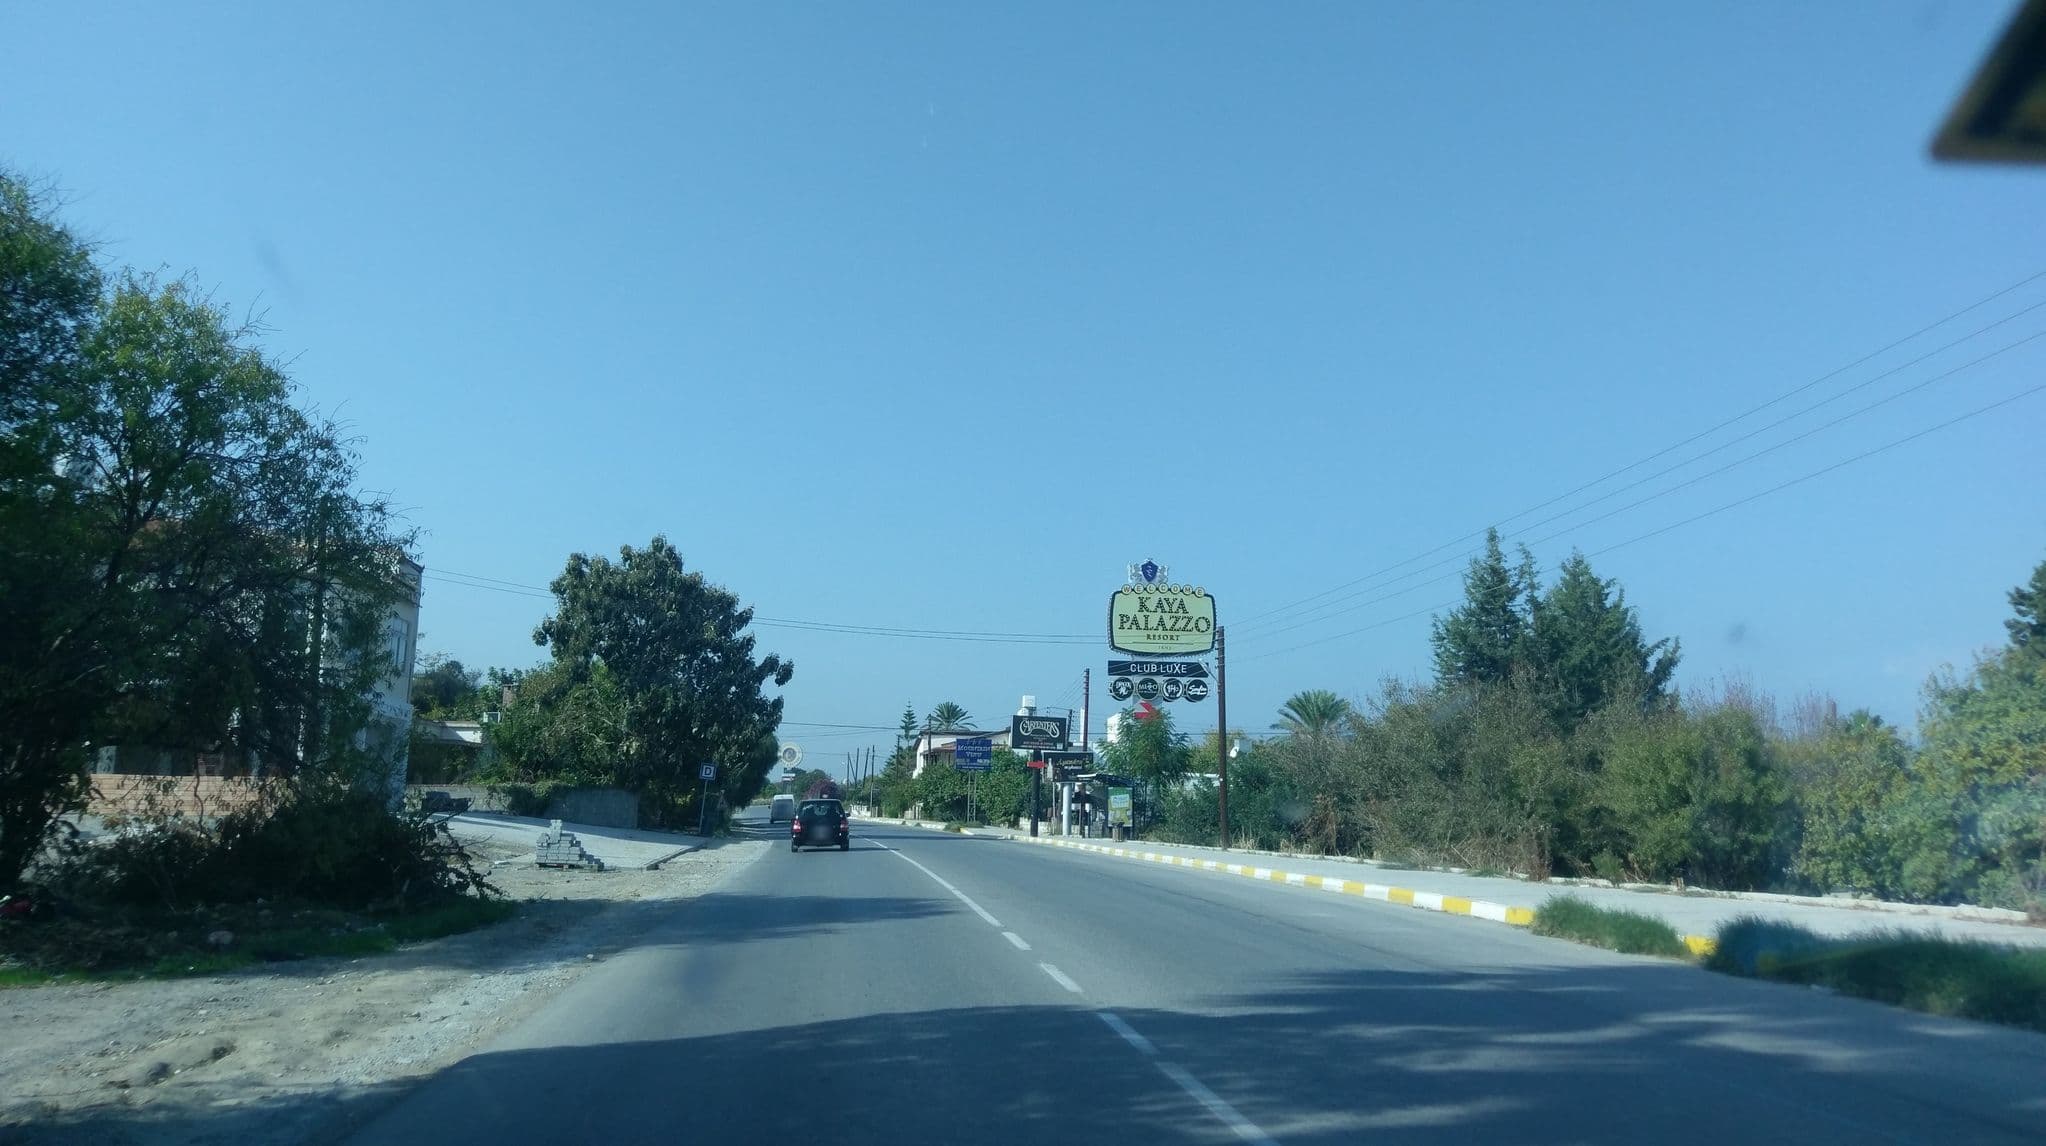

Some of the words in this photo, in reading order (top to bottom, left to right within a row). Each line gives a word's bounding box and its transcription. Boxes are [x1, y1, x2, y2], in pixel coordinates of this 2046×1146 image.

[1123, 585, 1203, 596] WELCOME
[1138, 596, 1189, 613] KAYA
[1118, 614, 1211, 633] PALAZZO
[1146, 633, 1180, 641] RESORT
[1130, 663, 1157, 673] CLUB
[1160, 663, 1187, 674] LUXE
